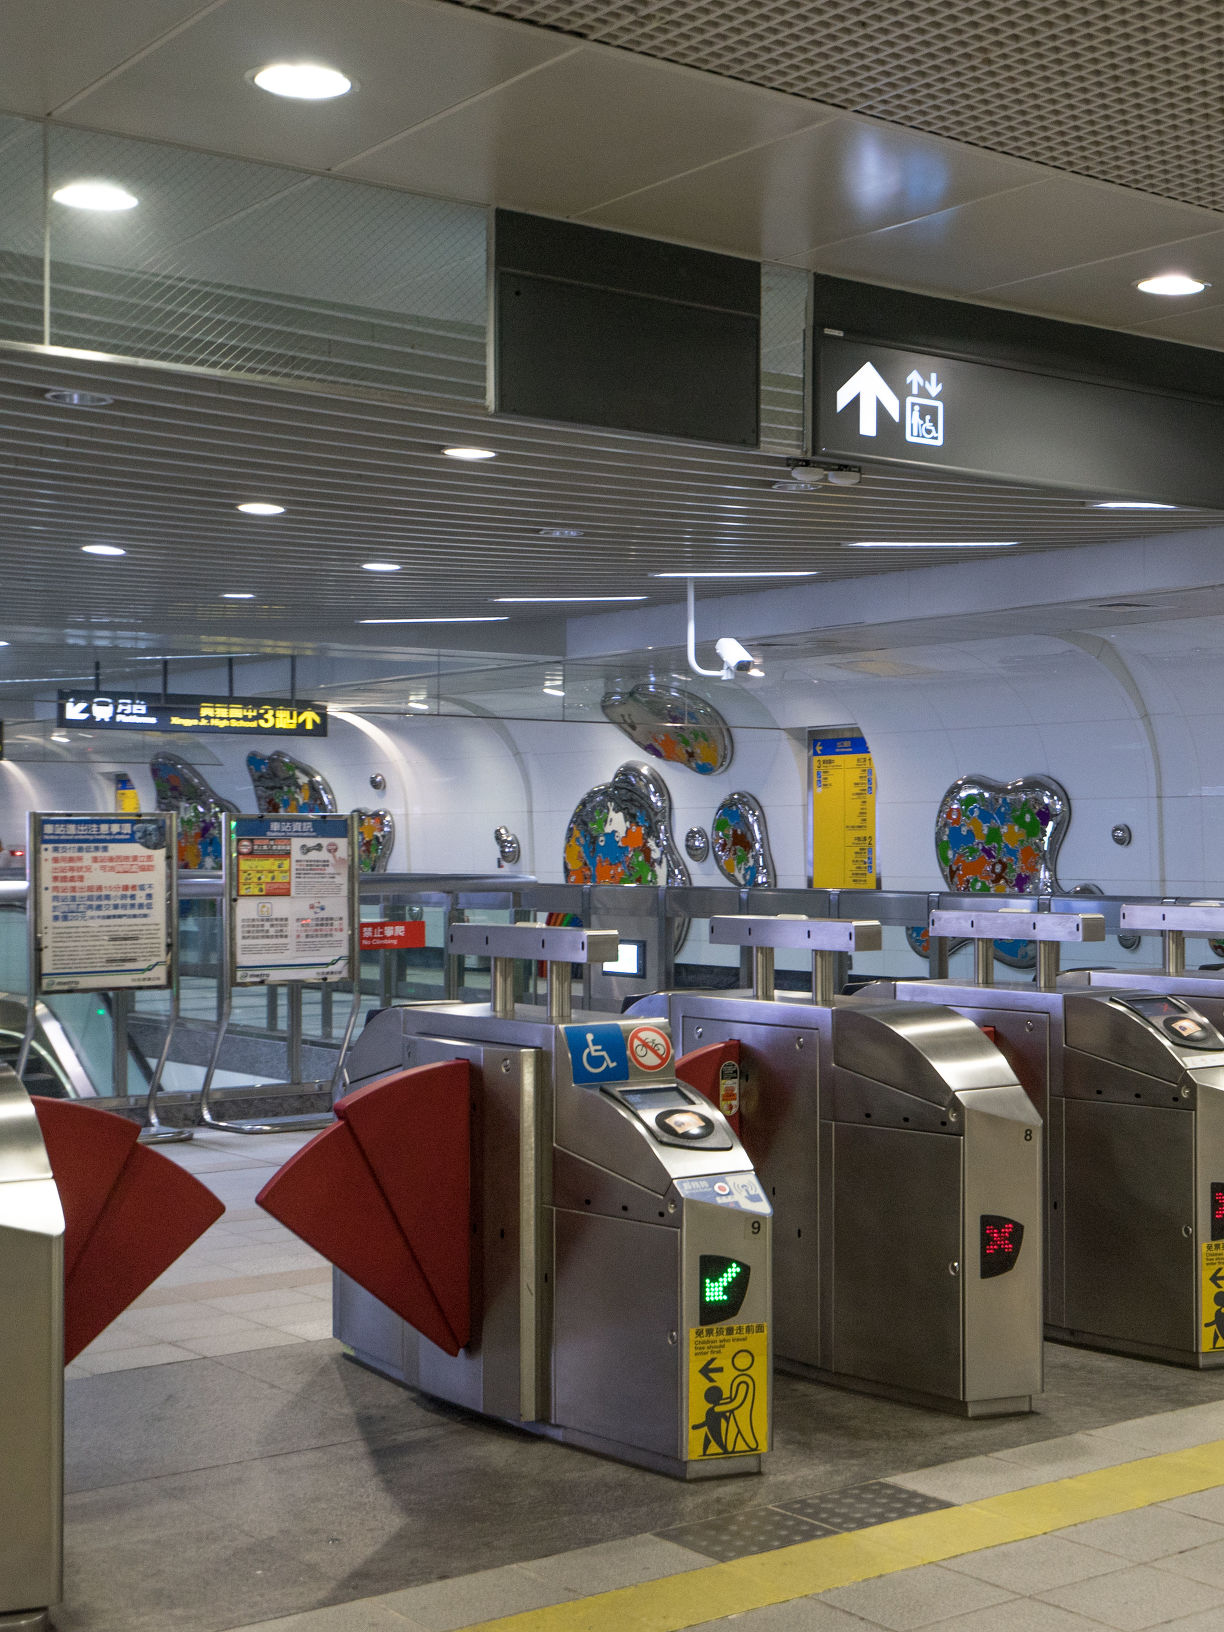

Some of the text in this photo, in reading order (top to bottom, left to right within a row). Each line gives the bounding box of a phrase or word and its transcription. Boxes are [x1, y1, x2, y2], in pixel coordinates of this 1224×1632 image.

[116, 699, 147, 715] 月台
[258, 705, 275, 729] 3
[270, 821, 313, 832] 車站資訊
[1024, 1128, 1033, 1142] 8
[751, 1220, 761, 1235] 9
[694, 1338, 718, 1346] Children
